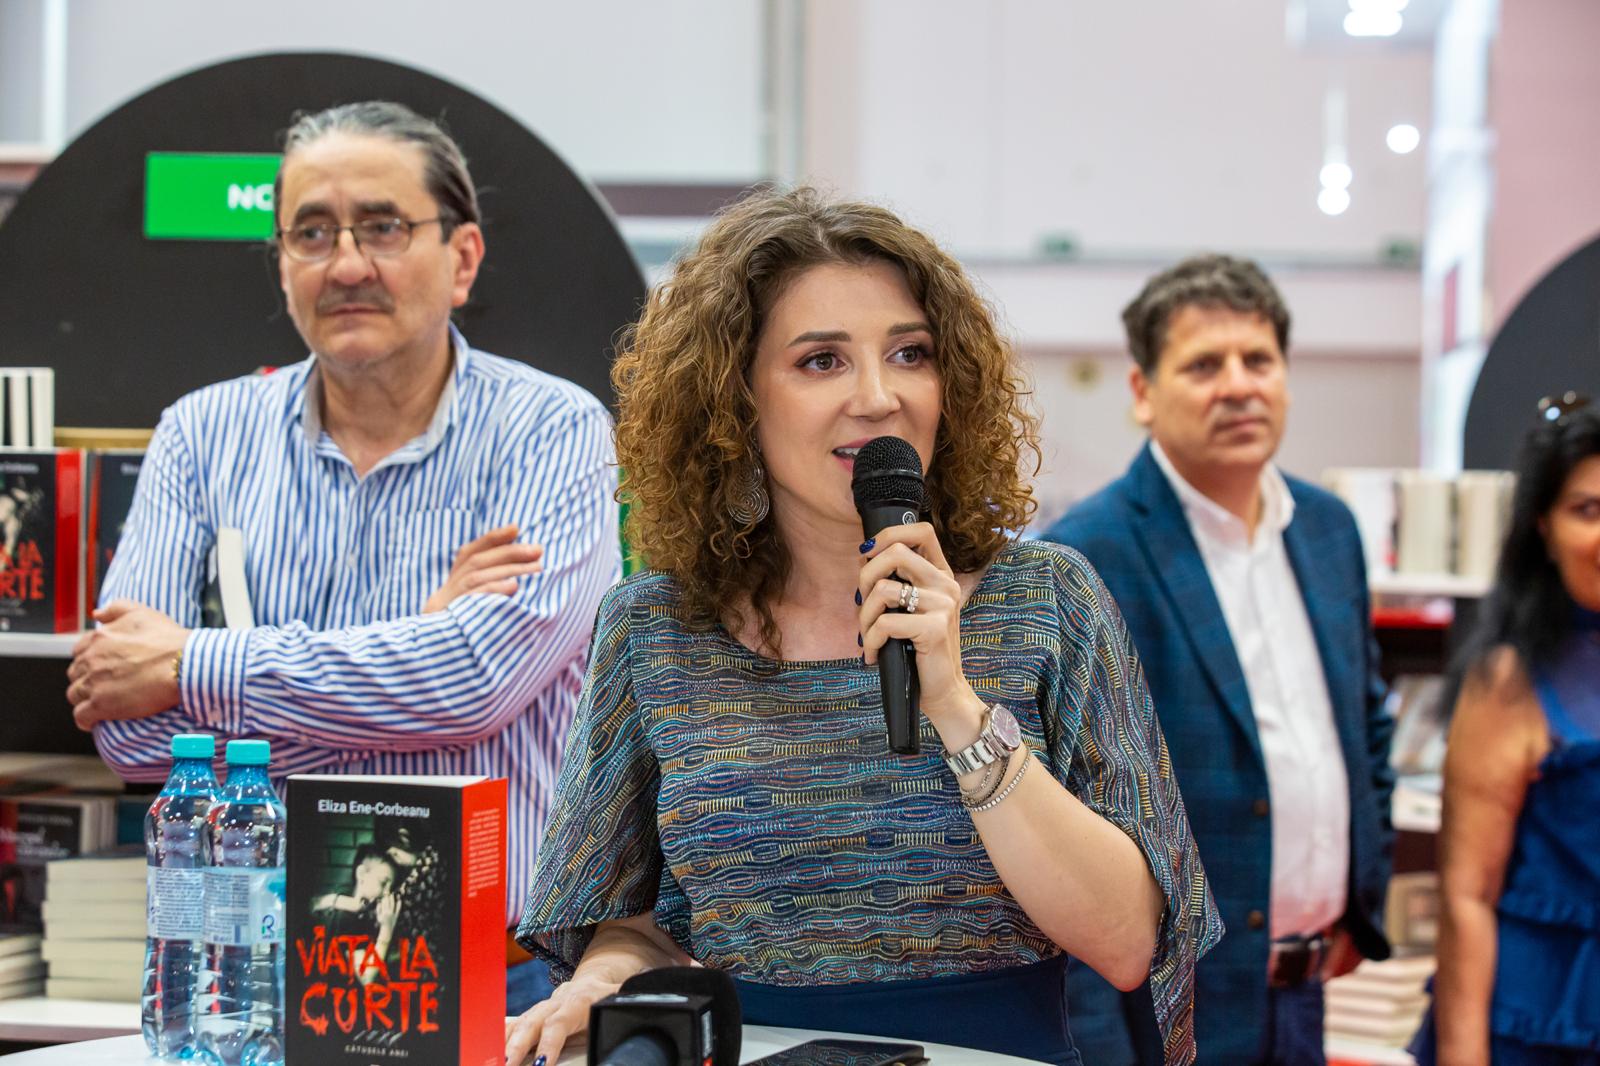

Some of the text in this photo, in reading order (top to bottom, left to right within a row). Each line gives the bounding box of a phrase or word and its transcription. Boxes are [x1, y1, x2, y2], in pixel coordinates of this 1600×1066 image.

[318, 799, 430, 818] Eliza Ene-Corbeanu
[400, 935, 438, 979] LA
[301, 981, 439, 1036] CURTE
